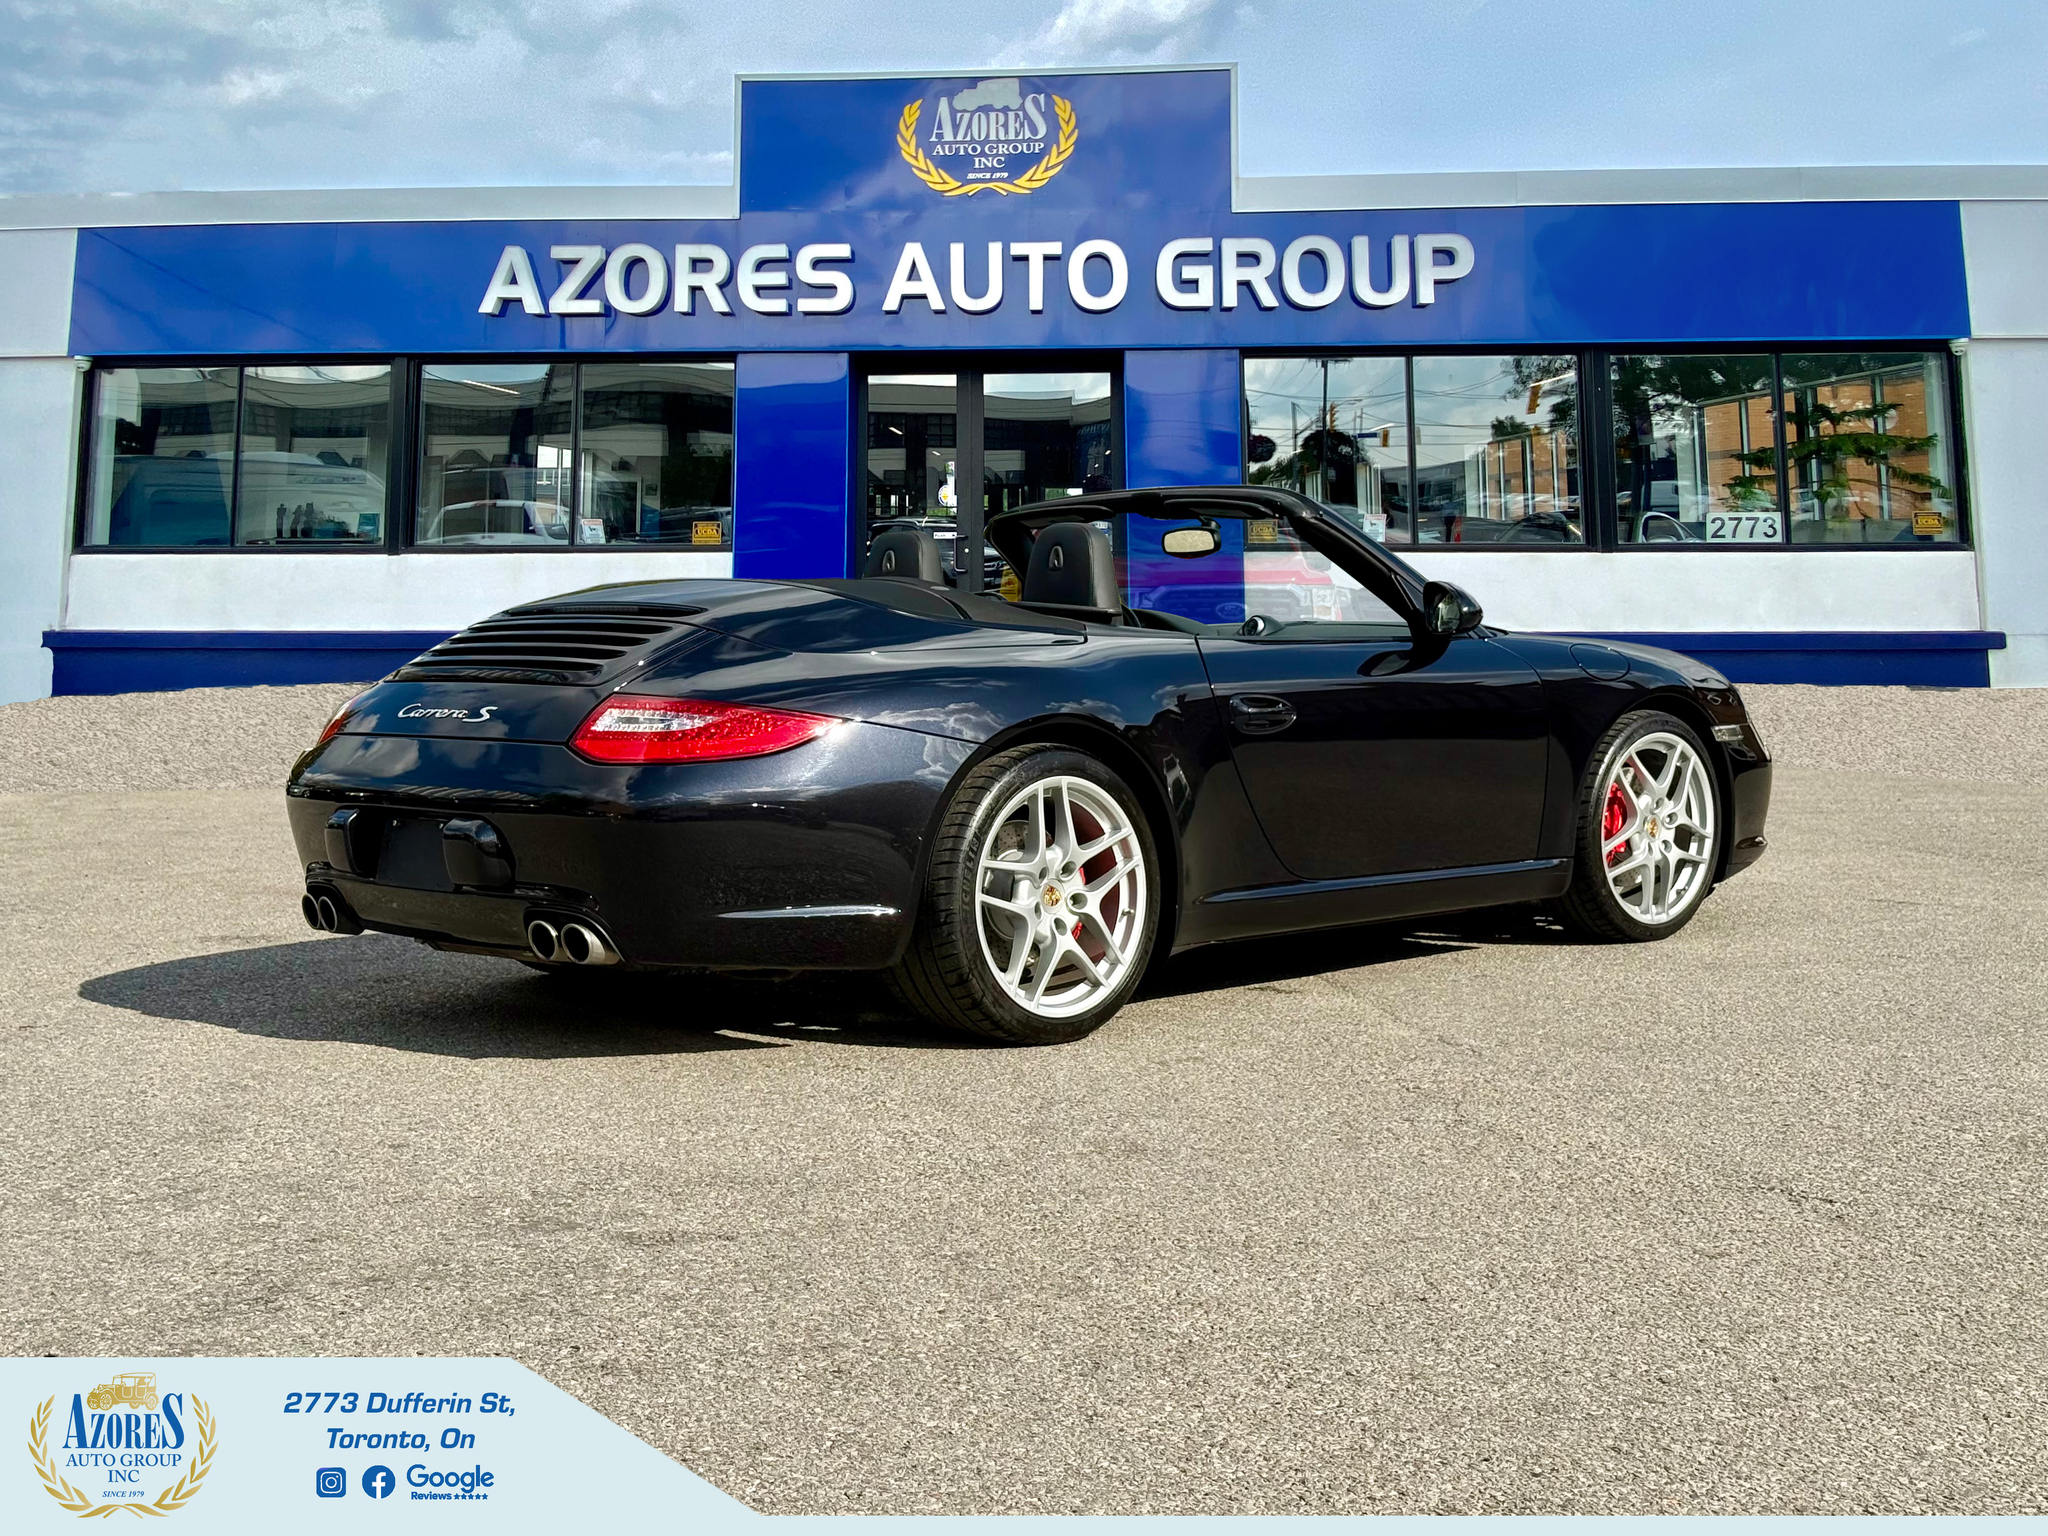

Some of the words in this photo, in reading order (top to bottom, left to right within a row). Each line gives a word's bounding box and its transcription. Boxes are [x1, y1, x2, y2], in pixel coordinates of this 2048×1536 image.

[929, 94, 1048, 142] AZORES
[932, 144, 981, 156] AUTO
[984, 142, 1044, 155] GROUP
[973, 157, 1005, 169] INC
[478, 242, 855, 317] AZORES
[882, 239, 1129, 313] AUTO
[1155, 234, 1475, 310] GROUP
[1710, 516, 1778, 539] 2773
[397, 703, 468, 718] Carrera
[461, 706, 499, 723] S
